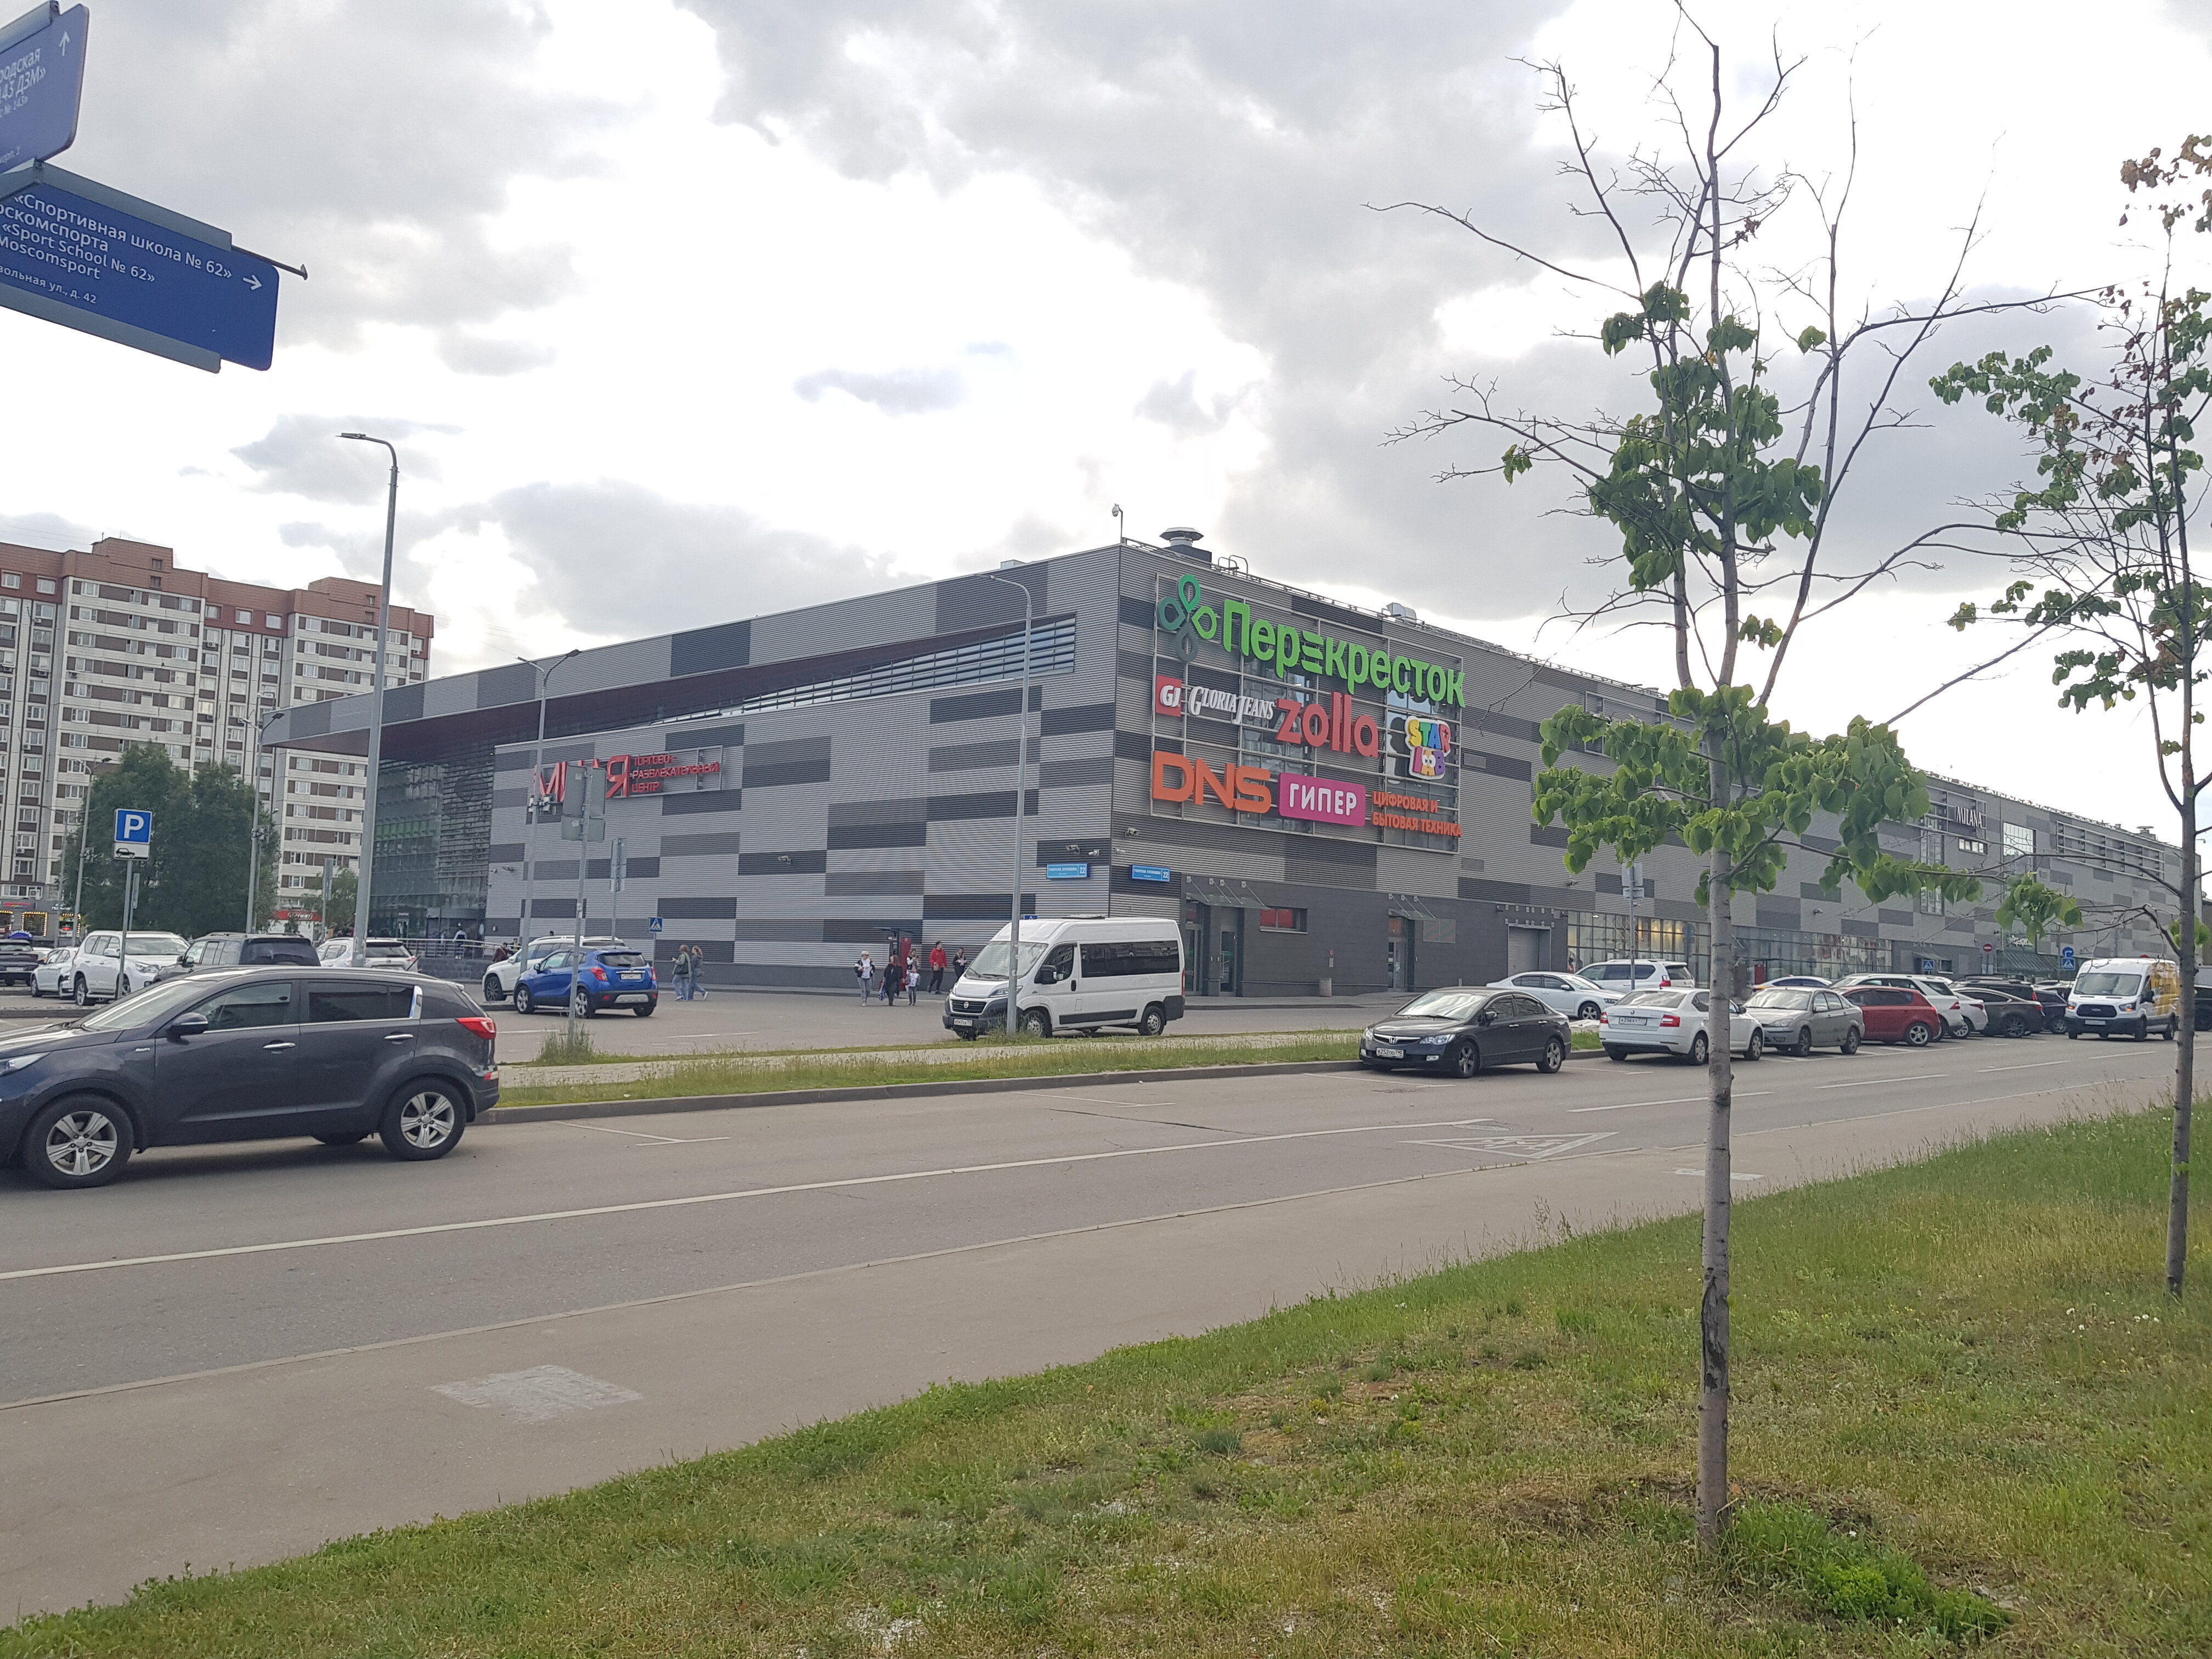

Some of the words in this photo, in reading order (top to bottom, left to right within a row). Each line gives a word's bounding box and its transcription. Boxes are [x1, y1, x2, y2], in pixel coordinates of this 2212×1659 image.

[15, 66, 46, 98] ДЗМ»
[14, 194, 127, 242] «Спортивная
[131, 234, 181, 262] школа
[185, 252, 201, 269] №
[206, 261, 232, 279] 62»
[0, 235, 100, 279] Moscomsport
[2, 223, 55, 249] «Sport
[58, 240, 107, 267] School
[111, 258, 126, 273] №
[131, 266, 155, 283] 62»
[70, 290, 81, 300] д.
[83, 293, 97, 304] 42
[1160, 685, 1181, 708] GJ
[1276, 691, 1379, 758] zolla
[1408, 719, 1451, 753] STAR
[631, 761, 720, 779] РАЗВЛЕКАТЕЛЬНЫЙ
[634, 755, 678, 766] ТОРГОВО-
[631, 782, 662, 792] ЦЕНТР
[1153, 751, 1272, 814] DNS
[1289, 783, 1357, 816] ГИПЕР
[1372, 791, 1429, 811] ЦИФРОВАЯ
[1430, 800, 1438, 813] И
[123, 814, 144, 839] P
[1372, 811, 1419, 831] БЫТОВАЯ
[1421, 819, 1463, 837] ТЕХНИКА
[1955, 806, 1982, 828] MILANA
